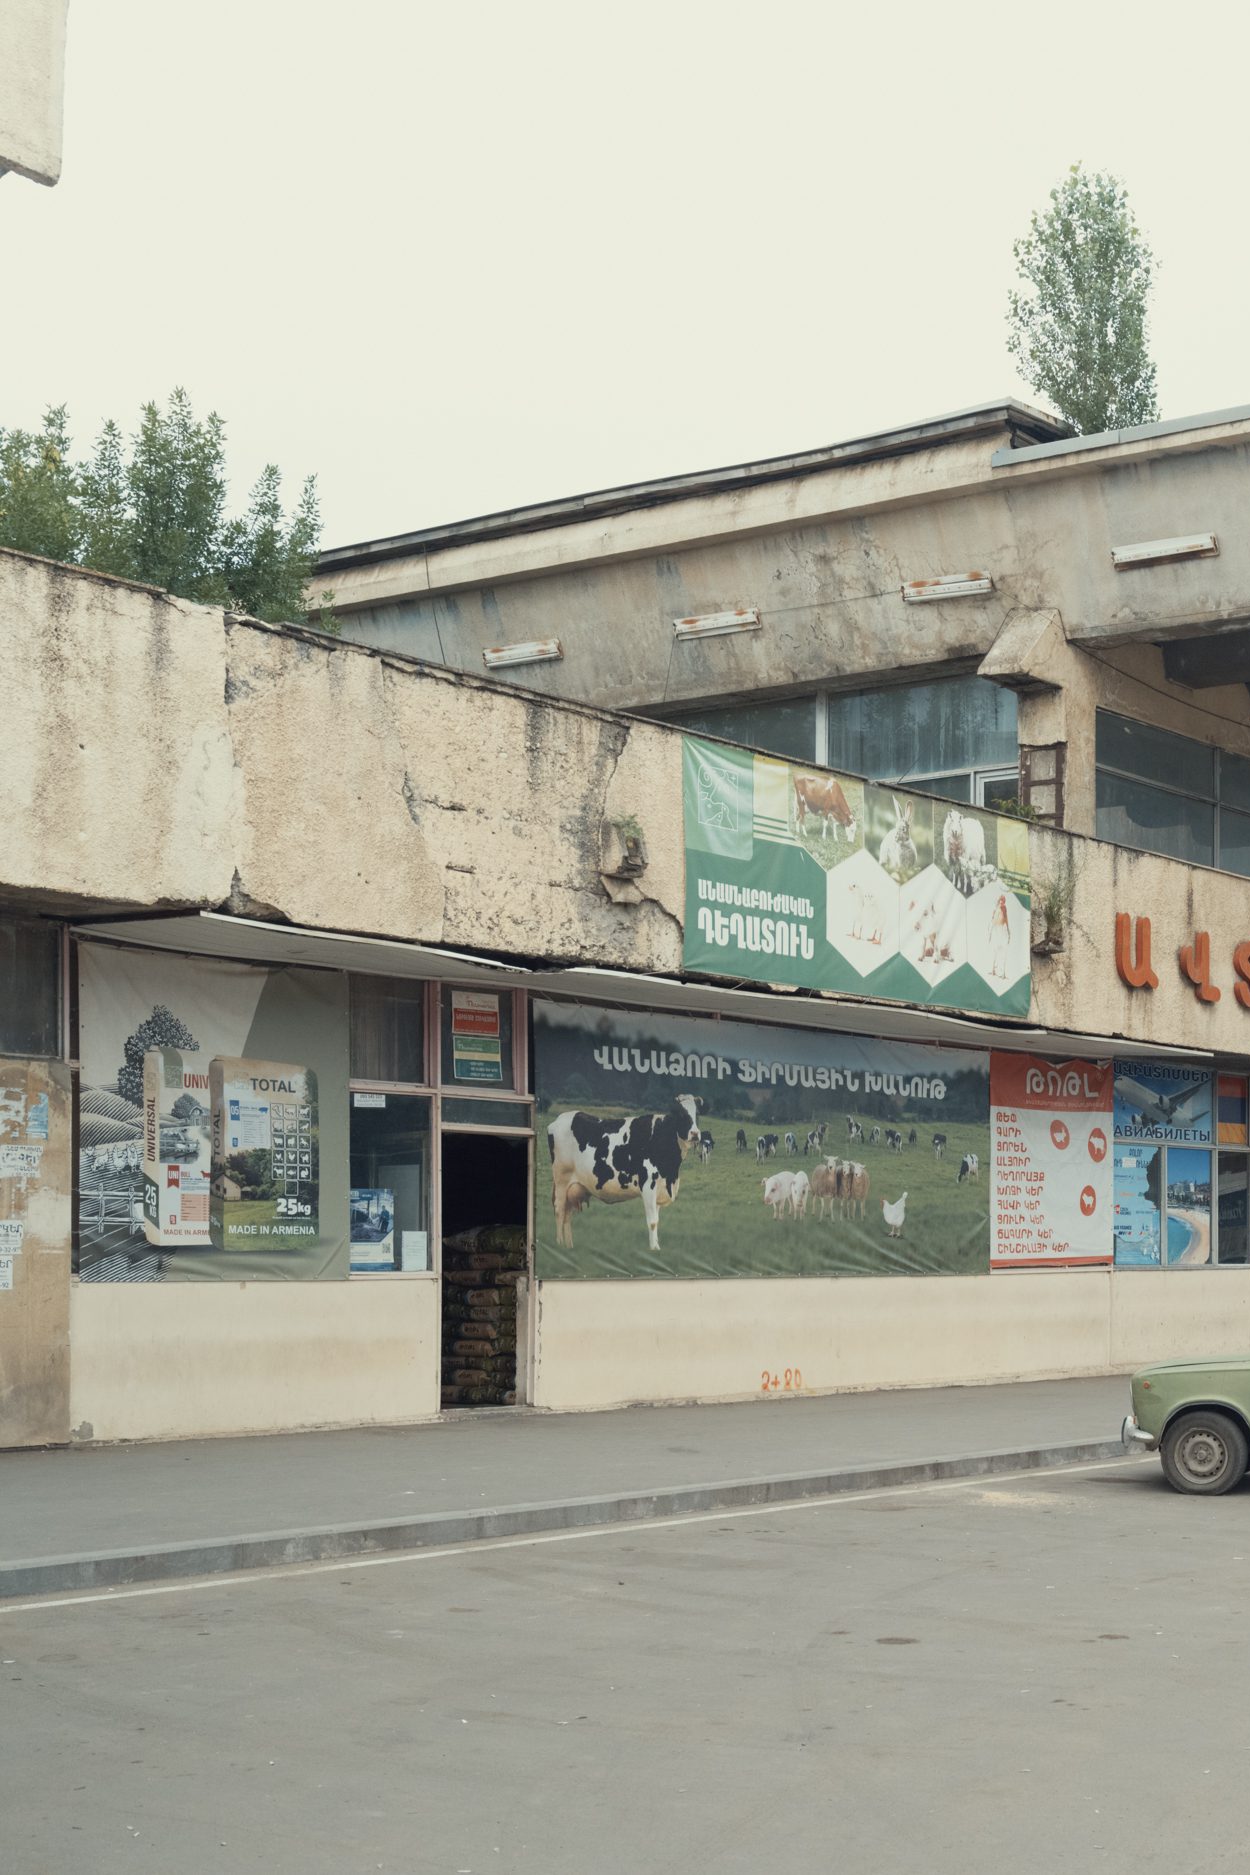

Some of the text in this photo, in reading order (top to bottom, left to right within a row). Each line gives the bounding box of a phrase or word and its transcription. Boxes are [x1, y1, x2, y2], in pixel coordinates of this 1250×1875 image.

[698, 878, 814, 919] ԱՆԱՍՆԱԲՈՒԺԱԿԱՆ
[697, 906, 814, 960] ԴԵՂԱՏՈՒՆ
[593, 1045, 947, 1100] ՎԱՆԱՁՈՐԻ ՖԻՐՄԱՅԻՆ ԽԱՆՈՒԹ
[250, 1078, 297, 1093] TOTAL
[147, 1096, 156, 1162] UNIVERSAL
[996, 1126, 1022, 1138] ԳԱՐԻ
[1113, 1124, 1210, 1142] АВИАБИЛЕТЫ
[996, 1141, 1028, 1153] ՑՈՐԵՆ
[996, 1156, 1031, 1167] ԱԼՅՈՒՐ
[168, 1168, 180, 1181] UNI
[145, 1183, 157, 1206] 25
[1025, 1186, 1043, 1196] ԿԵՐ
[276, 1198, 312, 1216] 25kg
[1024, 1200, 1041, 1211] ԿԵՐ
[149, 1207, 157, 1218] KG
[1029, 1214, 1045, 1225] ԿԵՐ
[163, 1228, 183, 1236] MADE
[228, 1224, 316, 1236] MADE IN ARMENIA
[1037, 1229, 1054, 1239] ԿԵՐ
[1052, 1242, 1070, 1253] ԿԵՐ
